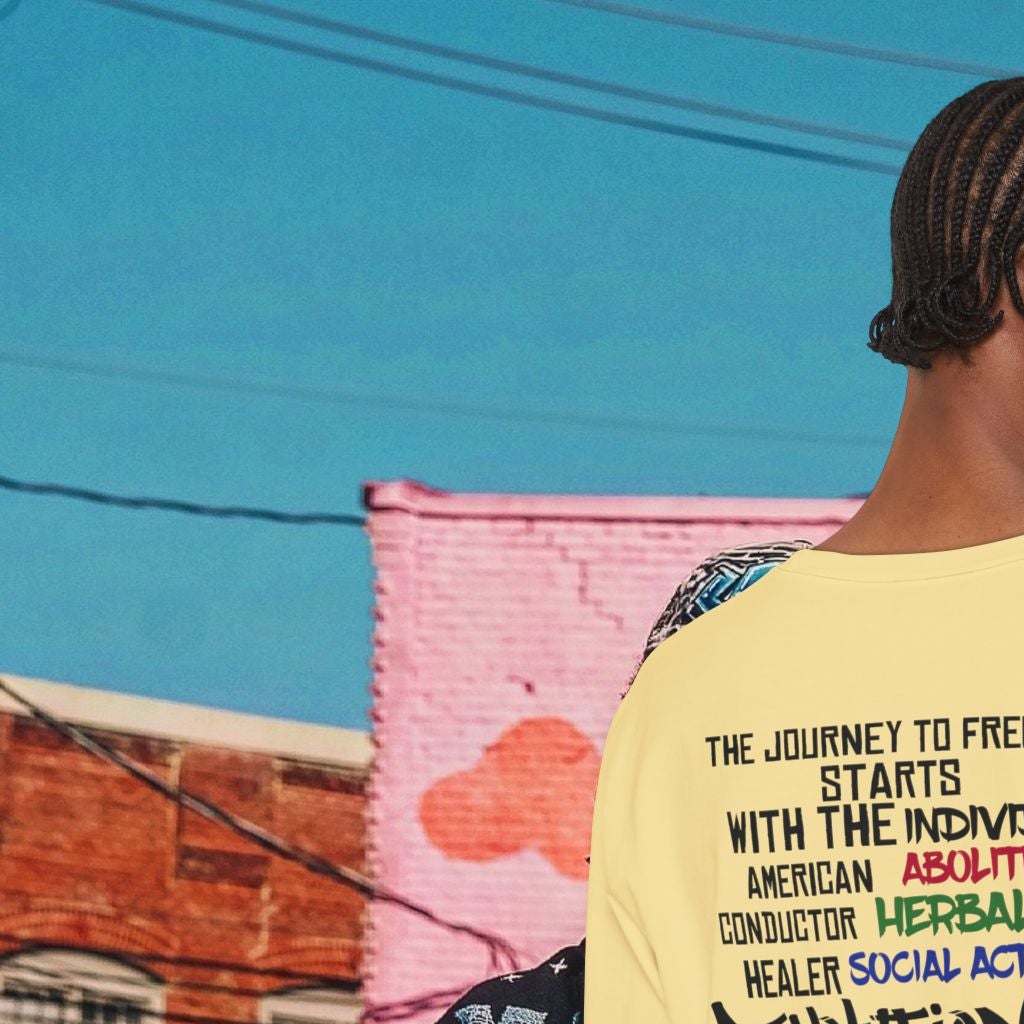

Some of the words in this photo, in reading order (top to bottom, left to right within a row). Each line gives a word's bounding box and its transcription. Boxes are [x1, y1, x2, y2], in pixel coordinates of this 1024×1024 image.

[705, 733, 755, 767] THE
[765, 721, 902, 762] JOURNEY
[914, 718, 950, 752] TO
[821, 759, 961, 802] STARTS
[727, 807, 805, 853] WITH
[817, 802, 897, 849] THE
[748, 859, 873, 899] AMERICAN
[718, 907, 857, 945] CONDUCTOR
[743, 956, 842, 998] HEALER
[849, 948, 961, 986] SOCIAL
